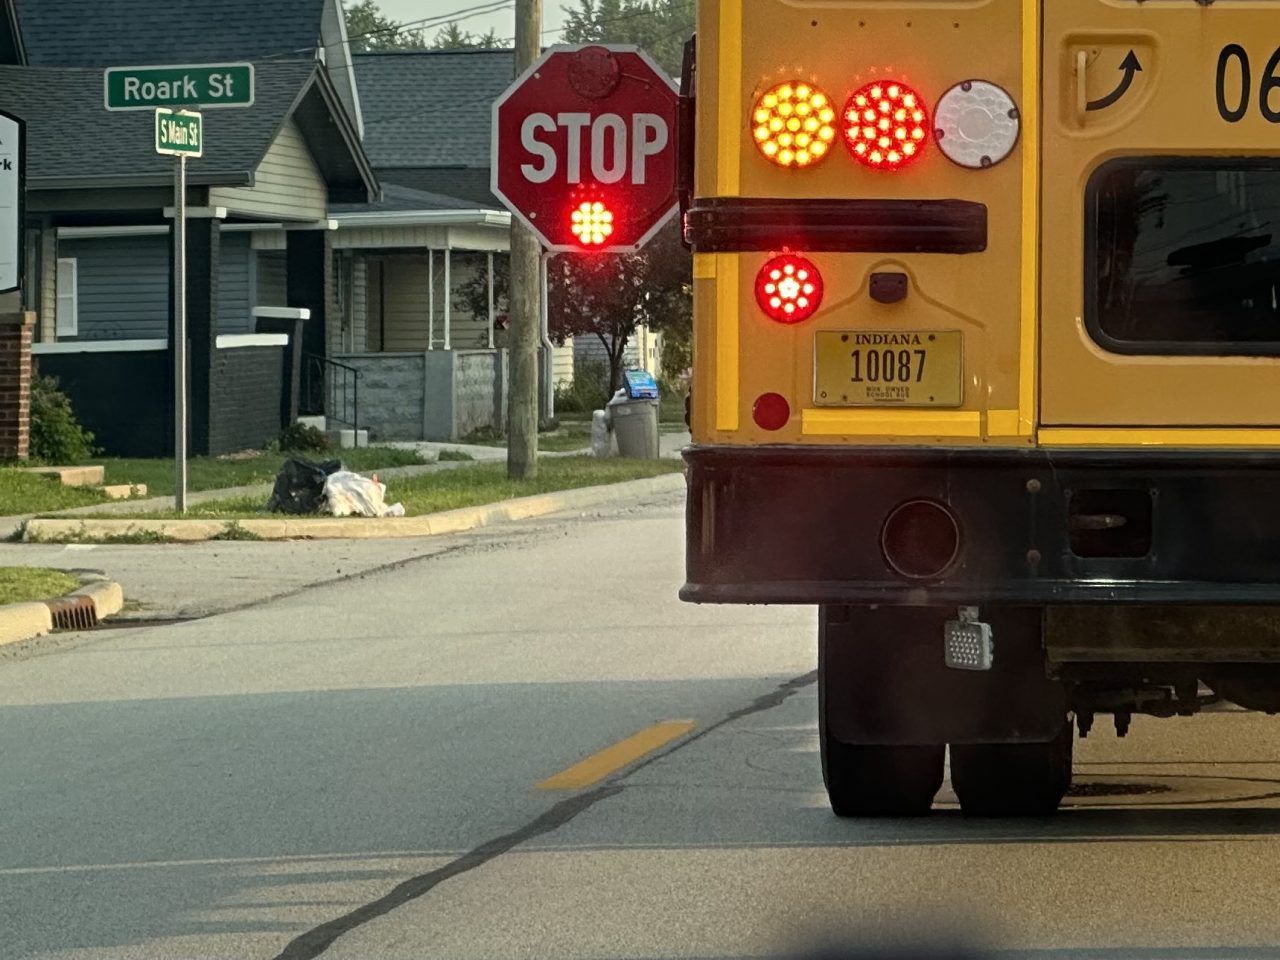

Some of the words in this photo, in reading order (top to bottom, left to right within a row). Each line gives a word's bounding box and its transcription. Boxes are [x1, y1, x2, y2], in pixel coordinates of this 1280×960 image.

[124, 75, 198, 101] Roark
[208, 73, 234, 97] St
[161, 119, 167, 143] S
[168, 120, 188, 144] Main
[189, 122, 198, 146] St
[520, 112, 669, 184] STOP
[855, 334, 921, 345] INDIANA
[851, 349, 926, 382] 10087
